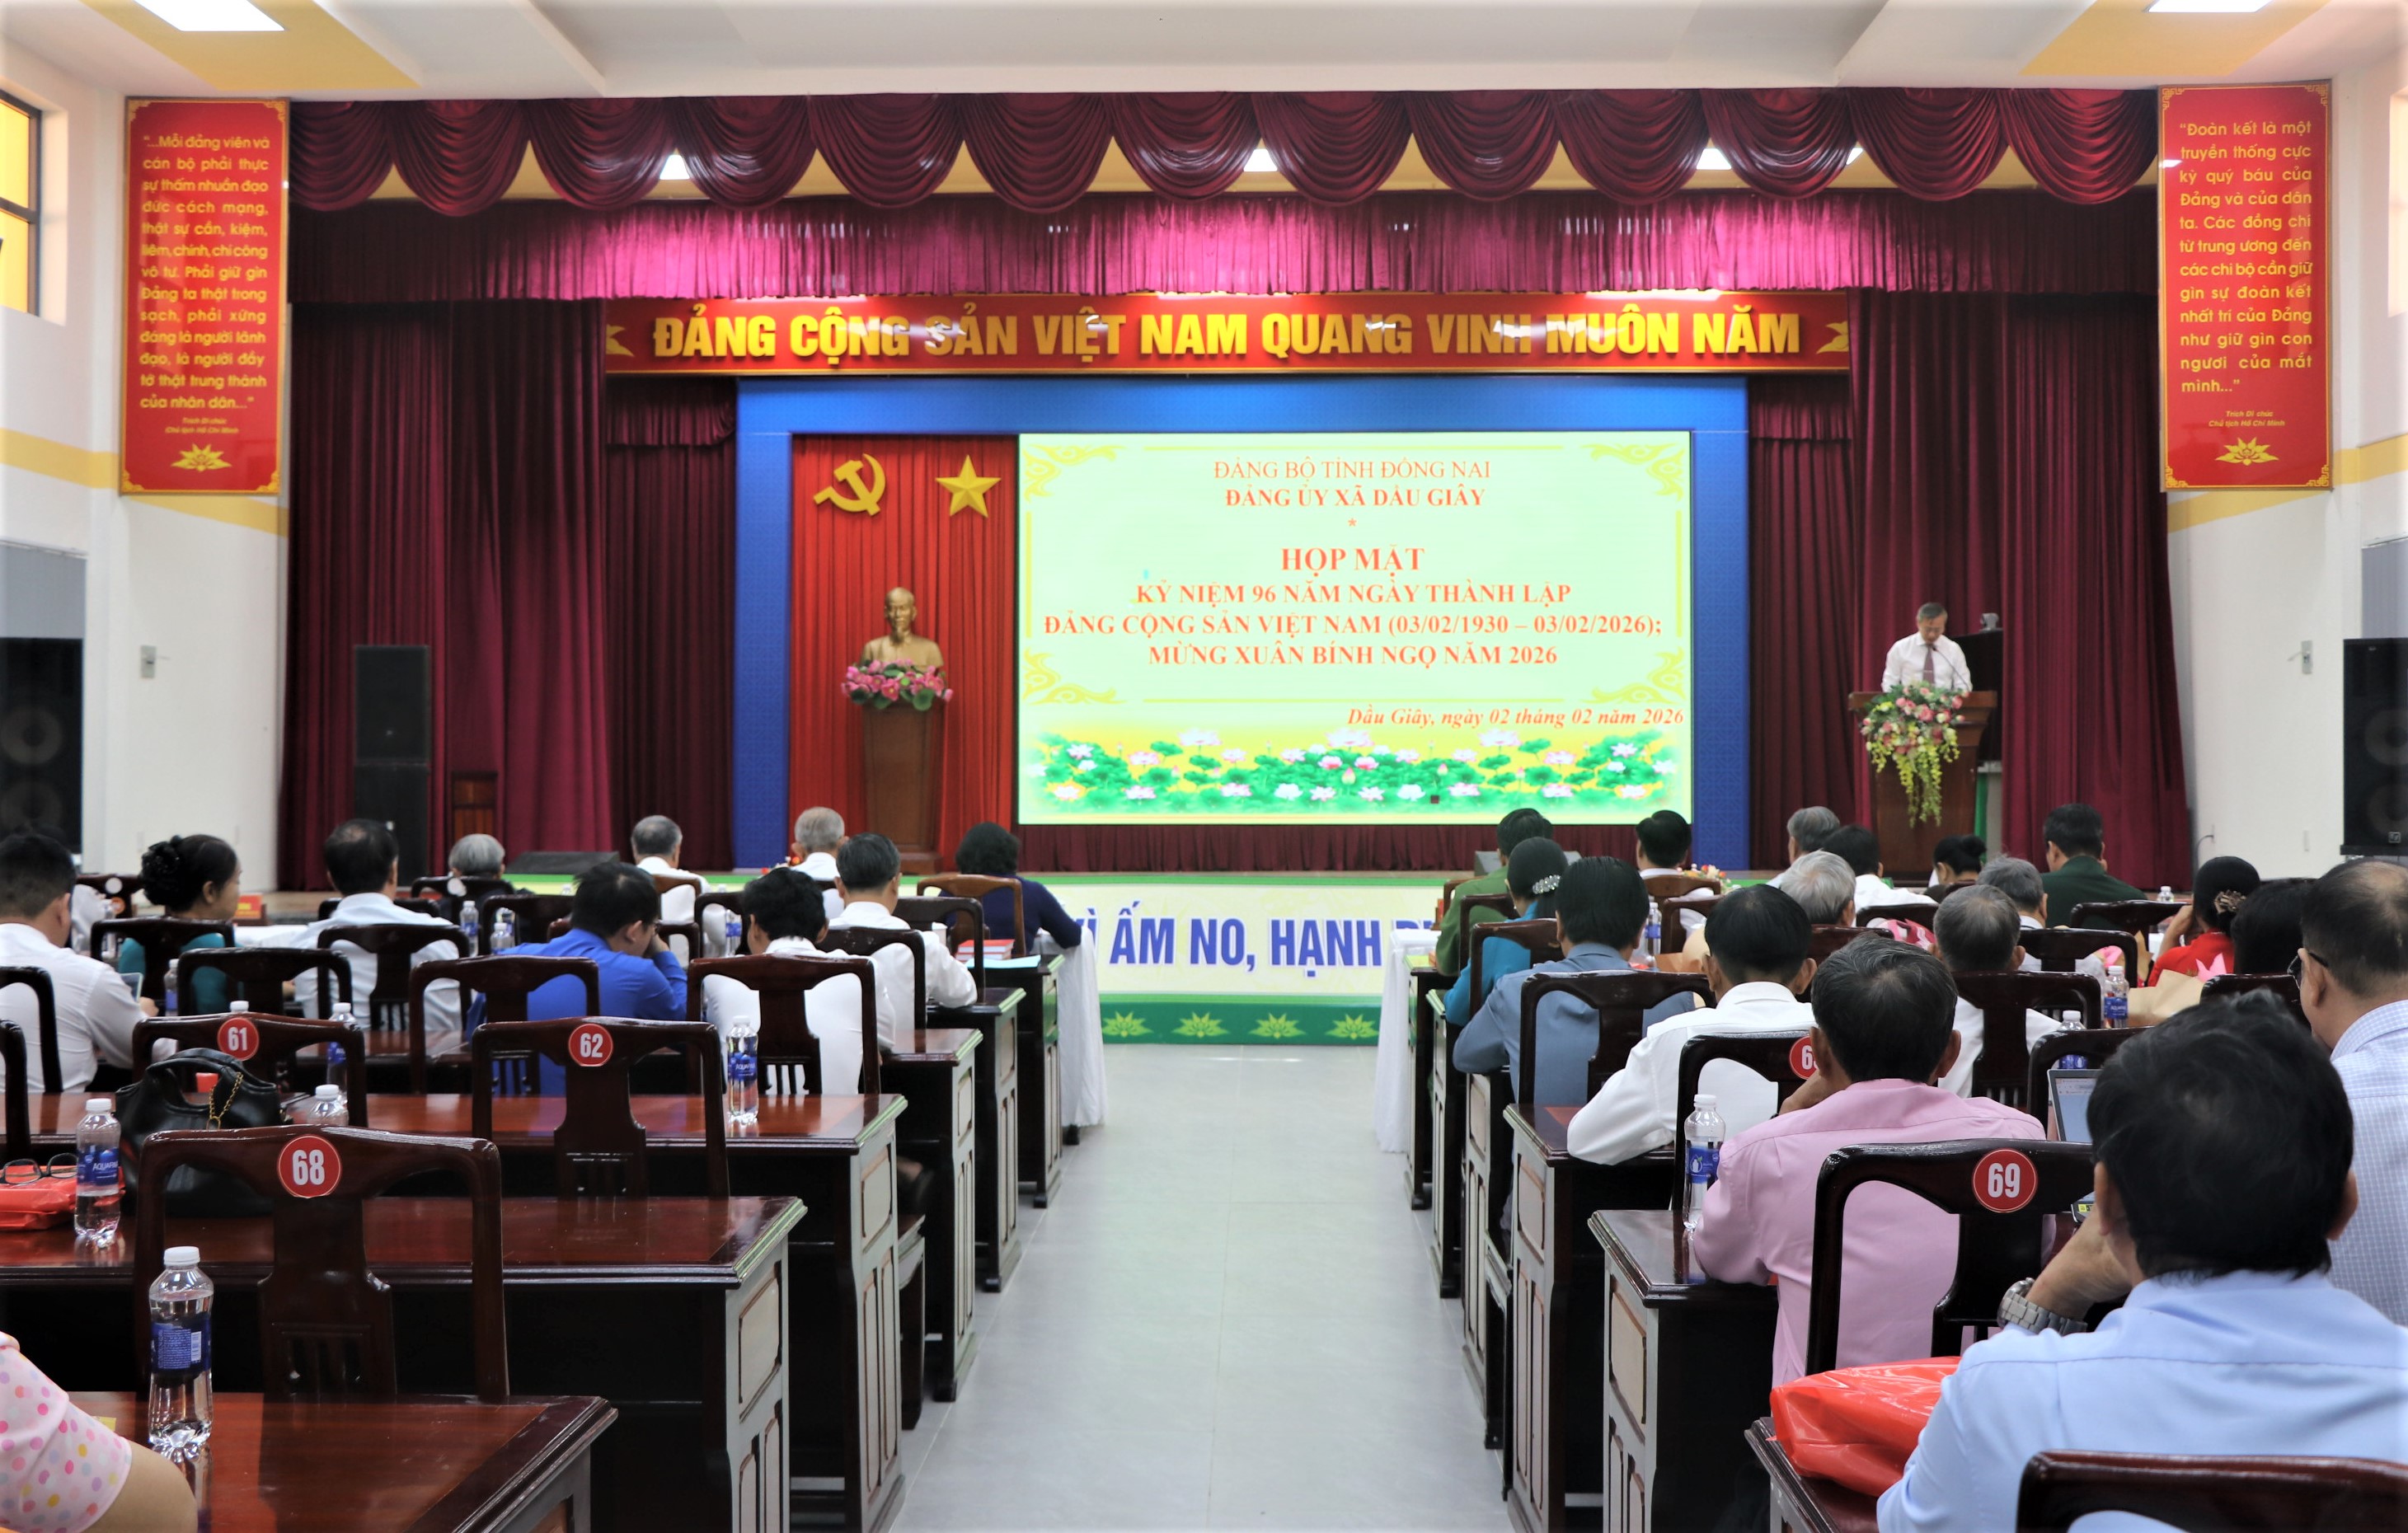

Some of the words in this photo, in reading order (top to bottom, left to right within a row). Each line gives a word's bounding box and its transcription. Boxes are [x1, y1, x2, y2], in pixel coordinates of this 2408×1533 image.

[2233, 120, 2257, 134] kết
[2263, 122, 2276, 134] là
[2282, 120, 2311, 136] một
[185, 134, 220, 151] đảng
[223, 135, 251, 148] viên
[254, 136, 270, 148] và
[2181, 144, 2227, 162] truyền
[2233, 144, 2276, 161] thống
[2283, 146, 2312, 160] cực
[143, 157, 170, 170] cán
[177, 157, 195, 171] bộ
[201, 156, 232, 172] phải
[239, 158, 269, 172] thực
[2180, 170, 2197, 185] kỳ
[2206, 169, 2233, 185] quý
[2243, 169, 2273, 181] báu
[2283, 166, 2312, 180] của
[143, 179, 158, 193] sự
[162, 177, 195, 191] thấm
[198, 177, 239, 191] nhuần
[241, 180, 268, 195] đạo
[143, 201, 170, 213] đức
[176, 200, 215, 213] cách
[223, 204, 269, 216] mạng,
[2180, 191, 2220, 208] Đảng
[2225, 193, 2243, 204] và
[2248, 190, 2277, 204] của
[2282, 192, 2312, 204] dân
[142, 223, 168, 234] thật
[174, 223, 189, 237] sự
[195, 222, 225, 236] cần,
[231, 223, 267, 237] kiệm,
[2180, 218, 2199, 229] ta.
[2204, 216, 2236, 229] Các
[2243, 213, 2282, 231] đồng
[2288, 215, 2311, 227] chí
[142, 245, 171, 257] liêm,
[173, 245, 211, 257] chính,
[212, 245, 232, 256] chí
[233, 246, 268, 260] công
[2180, 240, 2194, 252] từ
[2199, 241, 2235, 255] trung
[2240, 241, 2277, 255] ương
[2283, 237, 2312, 251] đến
[142, 265, 158, 278] vô
[164, 266, 179, 278] tư.
[185, 264, 214, 279] Phải
[219, 266, 241, 281] giữ
[246, 266, 267, 281] gìn
[2180, 262, 2208, 276] các
[2211, 263, 2232, 275] chi
[2236, 263, 2255, 279] bộ
[2258, 260, 2285, 275] cần
[2289, 262, 2312, 278] giữ
[142, 286, 178, 302] Đảng
[183, 288, 196, 299] ta
[201, 288, 228, 301] thật
[232, 288, 267, 302] trong
[2180, 288, 2204, 302] gìn
[2212, 288, 2228, 302] sự
[2237, 286, 2279, 298] đoàn
[2287, 284, 2311, 298] kết
[140, 309, 180, 323] sạch,
[187, 307, 221, 323] phải
[229, 309, 267, 325] xứng
[2180, 308, 2213, 322] nhất
[2218, 309, 2232, 322] trí
[2237, 307, 2266, 321] của
[2272, 307, 2312, 324] Đảng
[140, 331, 176, 345] đáng
[179, 331, 192, 343] là
[194, 331, 232, 345] người
[236, 331, 265, 343] lãnh
[654, 303, 776, 357] ĐẢNG
[790, 307, 909, 366] CỘNG
[924, 303, 1017, 357] SẢN
[1033, 307, 1126, 363] VIỆT
[1141, 313, 1247, 356] NAM
[1262, 312, 1412, 359] QUANG
[1427, 314, 1532, 354] VINH
[1547, 303, 1678, 354] MUÔN
[1693, 305, 1800, 354] NĂM
[2180, 334, 2210, 345] như
[2218, 333, 2243, 349] giữ
[2250, 333, 2274, 348] gìn
[2282, 335, 2312, 345] con
[139, 353, 171, 367] đạo,
[176, 352, 190, 364] là
[194, 353, 232, 368] người
[237, 350, 265, 367] đầy
[2180, 357, 2227, 373] ngươi
[2239, 354, 2270, 368] của
[2280, 352, 2312, 368] mắt
[140, 374, 155, 387] tớ
[159, 374, 185, 388] thật
[190, 375, 224, 389] trung
[228, 374, 267, 387] thành
[140, 394, 167, 408] của
[171, 396, 205, 408] nhân
[1214, 457, 1279, 478] ĐẢNG
[1285, 456, 1316, 482] BỘ
[1321, 457, 1374, 478] TỈNH
[1381, 456, 1444, 478] ĐỒNG
[1452, 462, 1490, 478] NAI
[1225, 484, 1291, 506] ĐẢNG
[1298, 484, 1328, 506] ỦY
[1335, 485, 1366, 506] XÃ
[1427, 483, 1485, 506] GIÂY
[1281, 547, 1346, 577] HỌP
[1354, 544, 1425, 577] MẶT
[1137, 579, 1172, 603] KỶ
[1180, 583, 1244, 607] NIỆM
[1252, 585, 1276, 602] 96
[1284, 580, 1340, 602] NĂM
[1349, 579, 1420, 603] NGÀY
[1426, 579, 1514, 602] THÀNH
[1523, 581, 1571, 607] LẬP
[1044, 610, 1115, 634] ĐẢNG
[1122, 612, 1195, 639] CỘNG
[1202, 610, 1250, 634] SẢN
[1258, 612, 1317, 639] VIỆT
[1324, 615, 1381, 634] NAM
[1388, 615, 1509, 636] (03/02/1930
[1533, 615, 1662, 637] 03/02/2026);
[1148, 640, 1227, 665] MỪNG
[1235, 640, 1304, 664] XUÂN
[1312, 640, 1373, 664] BÍNH
[1381, 645, 1437, 669] NGỌ
[1443, 641, 1501, 664] NĂM
[1509, 645, 1557, 664] 2026
[1347, 705, 1384, 725] Dầu
[1391, 708, 1436, 728] Giây,
[1442, 710, 1484, 729] ngày
[1490, 710, 1509, 724] 02
[1515, 708, 1565, 729] tháng
[1572, 709, 1592, 724] 02
[1598, 710, 1636, 724] năm
[1642, 709, 1684, 724] 2026
[1110, 901, 1174, 964] ẤM
[1190, 918, 1256, 972] NO,
[1271, 919, 1381, 977] HẠNH
[228, 1026, 248, 1052] 61
[580, 1034, 603, 1058] 62
[1802, 1045, 1819, 1070] 6
[292, 1149, 325, 1185] 68
[1987, 1162, 2021, 1198] 69
